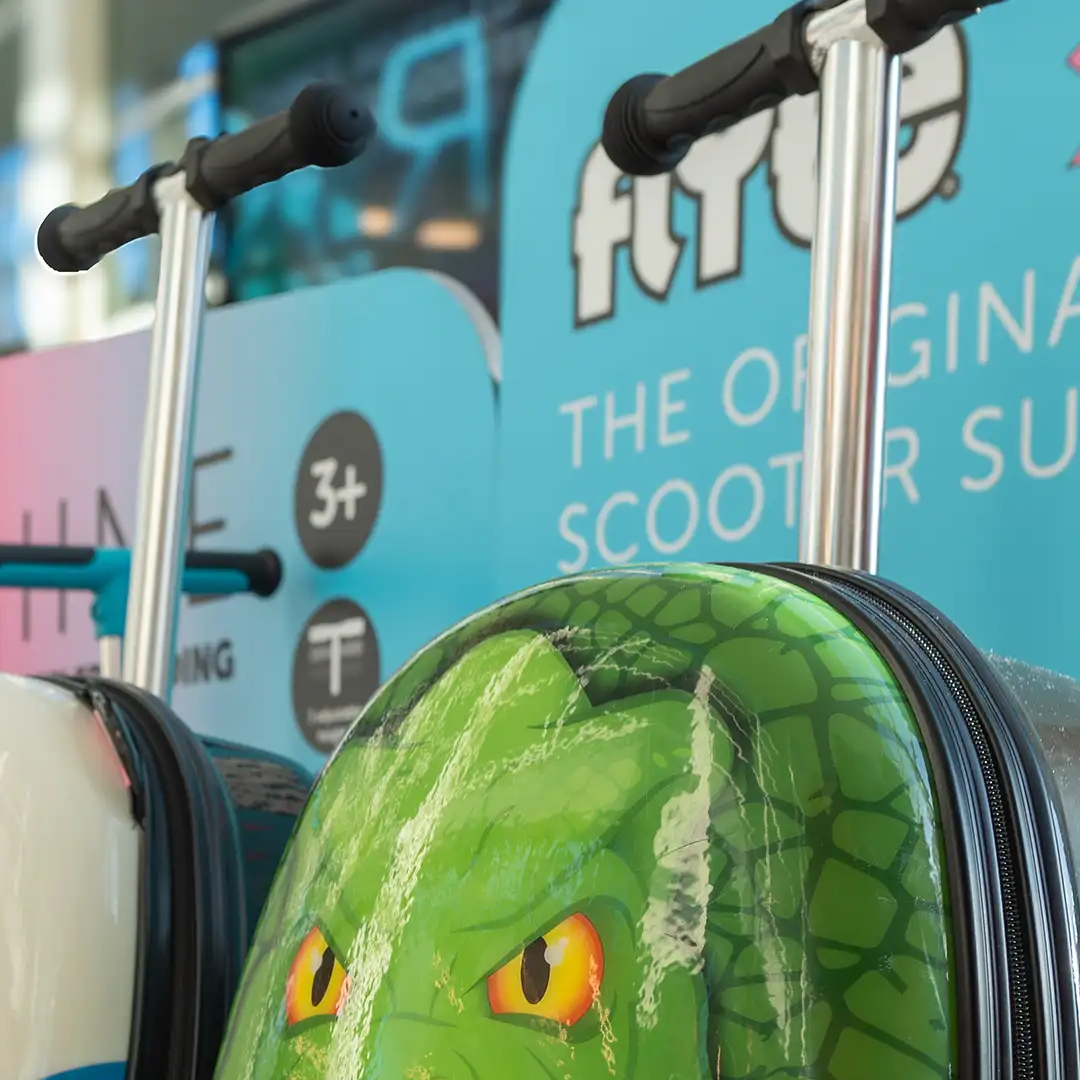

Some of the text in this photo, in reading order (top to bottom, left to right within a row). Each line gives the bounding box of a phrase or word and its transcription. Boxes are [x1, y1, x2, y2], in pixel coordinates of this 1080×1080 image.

[559, 369, 691, 468] THE
[309, 457, 367, 528] 3+
[557, 427, 920, 573] SCOOTR
